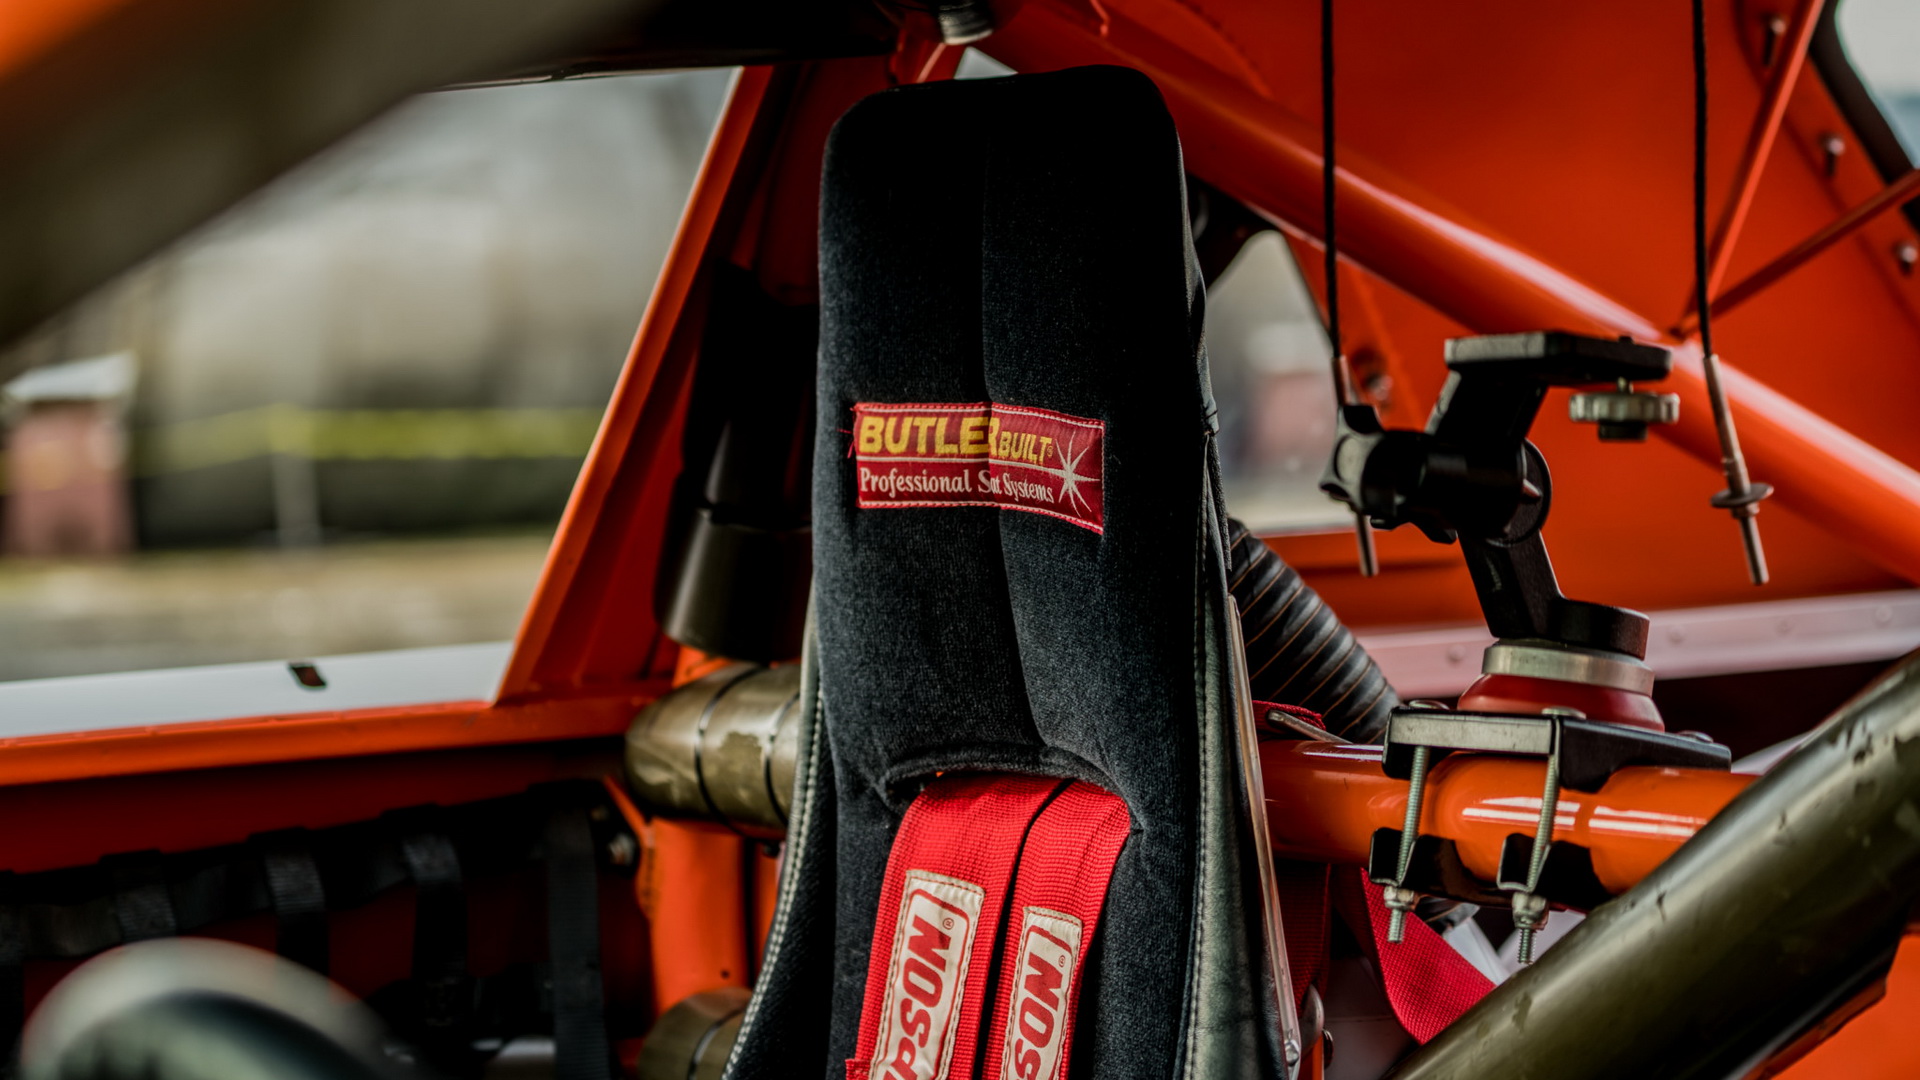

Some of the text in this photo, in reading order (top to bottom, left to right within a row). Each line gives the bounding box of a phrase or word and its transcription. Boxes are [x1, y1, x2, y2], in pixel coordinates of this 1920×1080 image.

[859, 467, 1055, 503] Professional Sat Systems
